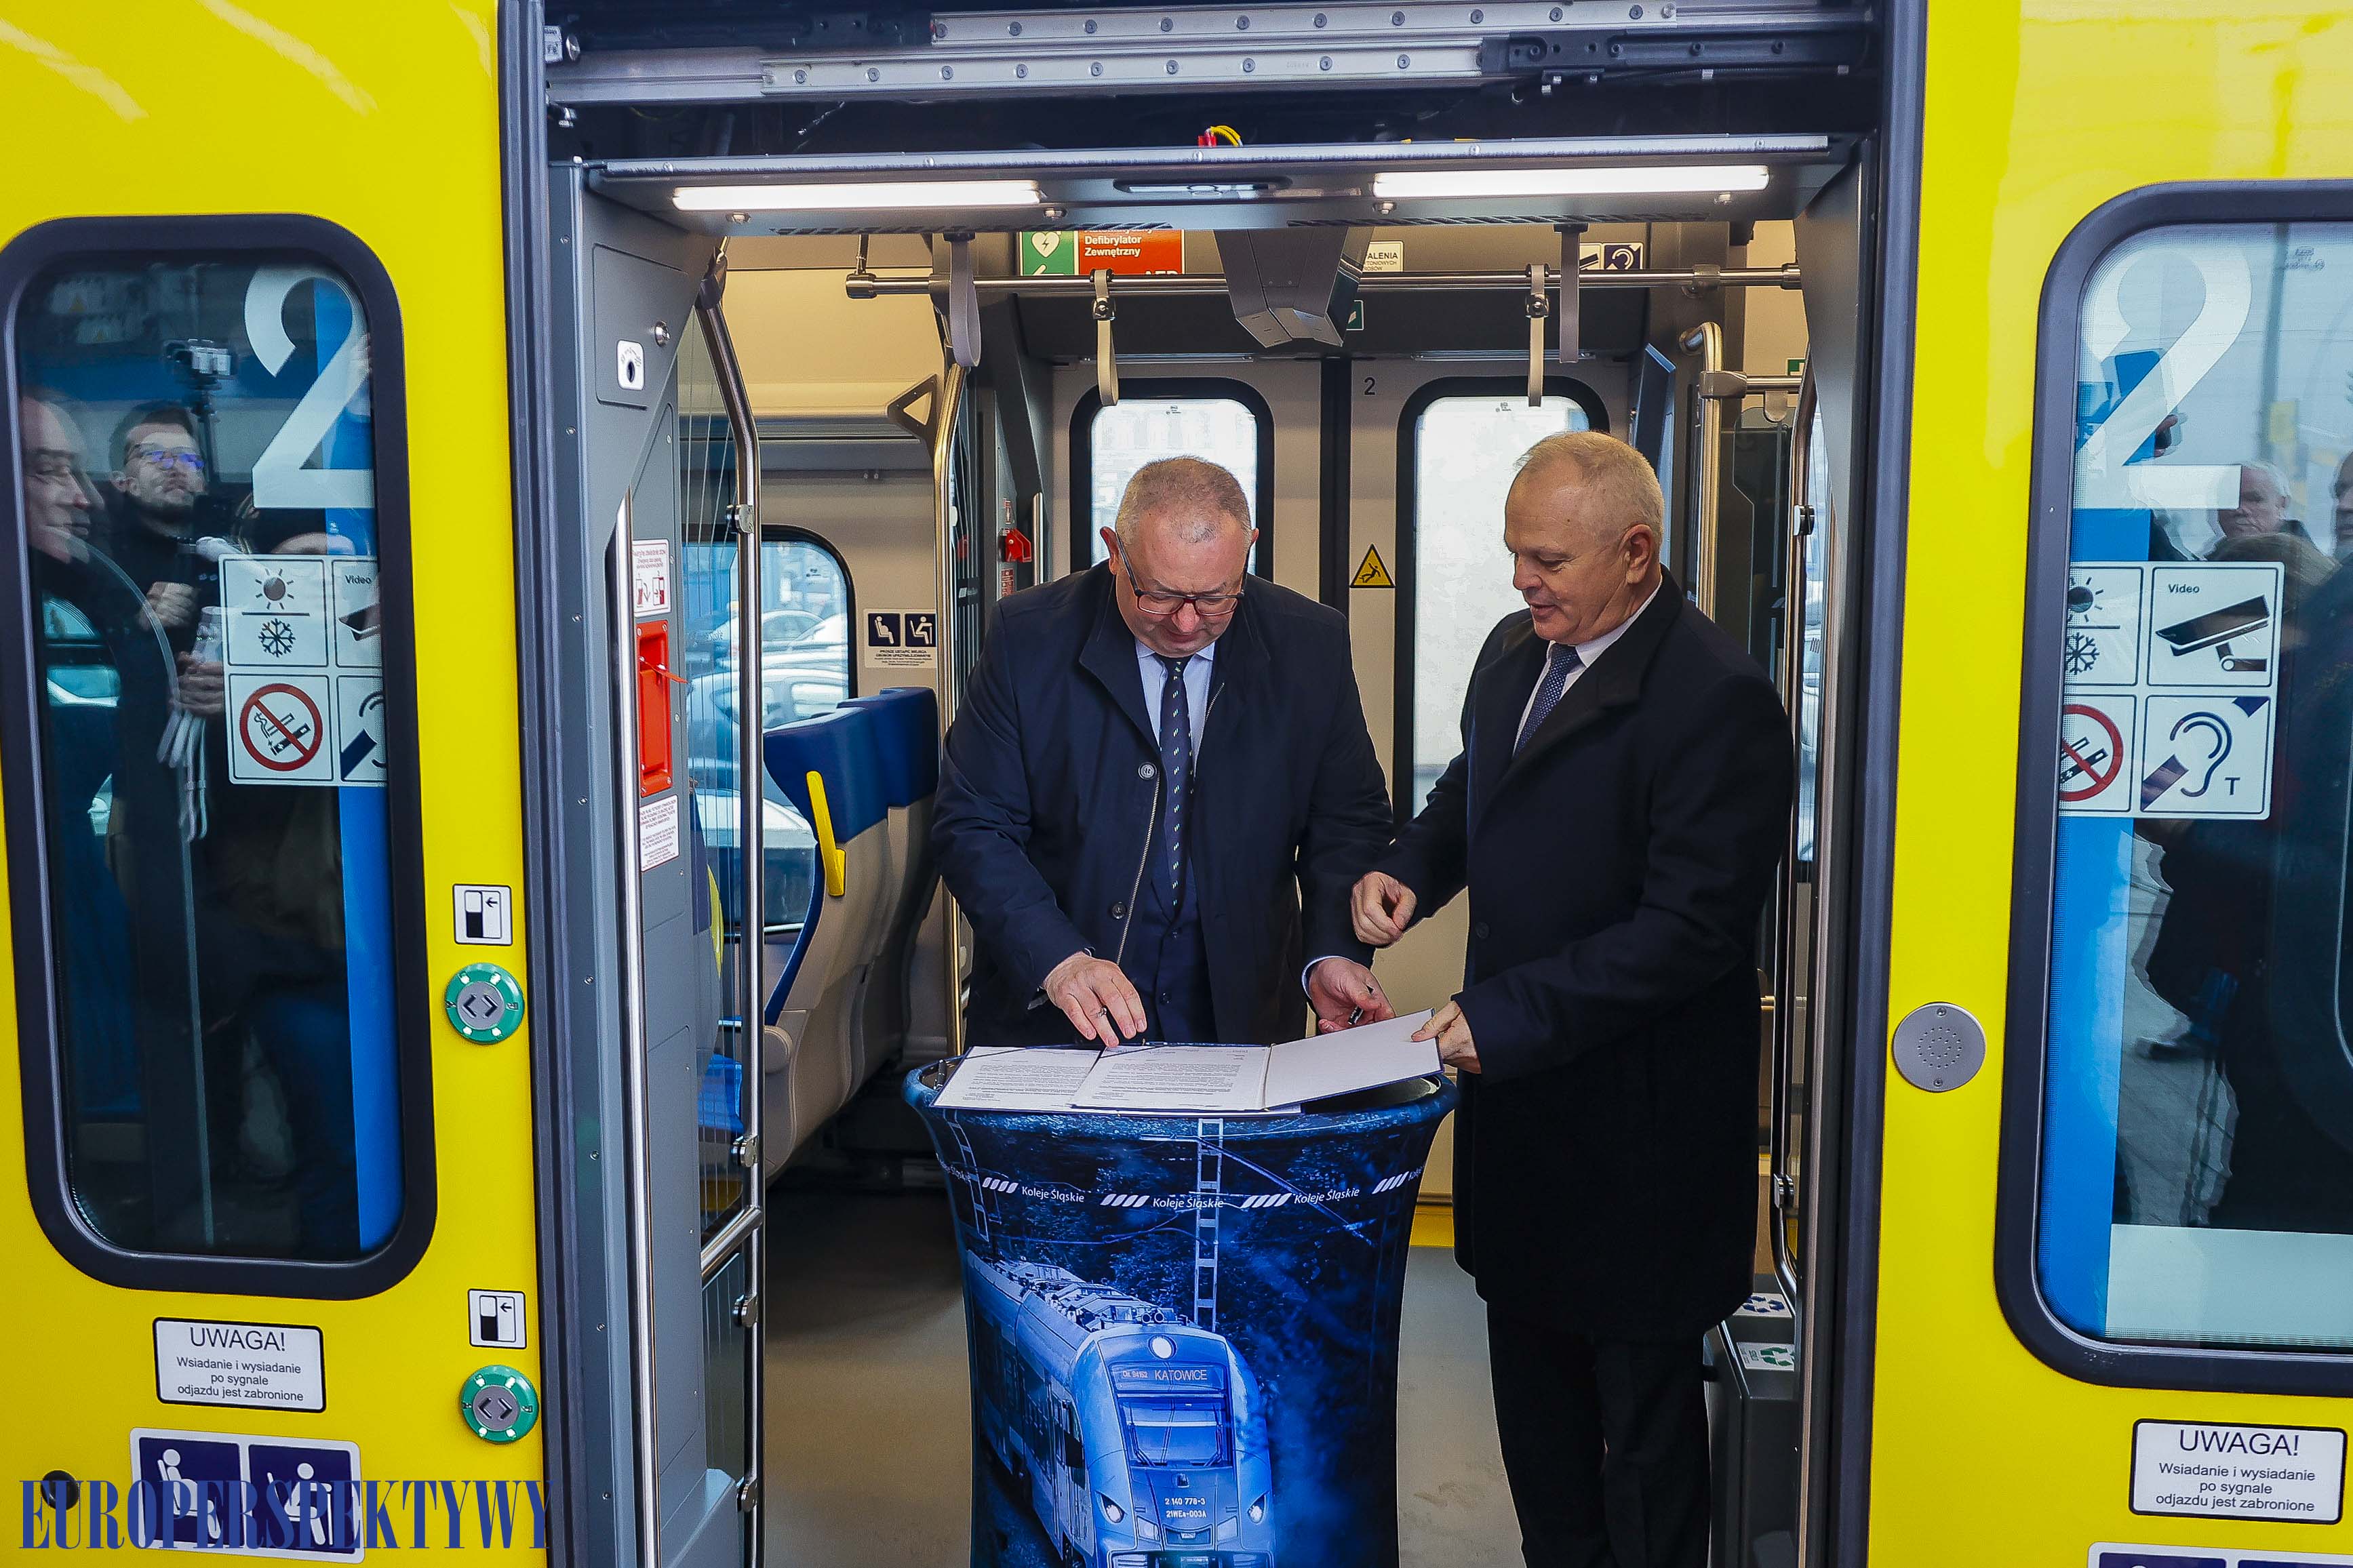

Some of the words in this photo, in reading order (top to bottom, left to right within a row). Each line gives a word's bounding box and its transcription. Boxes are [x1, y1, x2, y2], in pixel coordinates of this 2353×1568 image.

[1084, 235, 1142, 246] Defibrylator
[1084, 247, 1141, 258] Zewnętrzny
[2076, 245, 2253, 509] 2
[244, 263, 375, 509] 2
[1363, 378, 1376, 396] 2
[344, 575, 372, 585] Video
[2168, 583, 2200, 595] Video
[2224, 777, 2240, 795] T
[1022, 1186, 1049, 1200] Koleje
[1051, 1189, 1085, 1203] Śląskie
[1153, 1197, 1185, 1209] Koleje
[1187, 1197, 1224, 1209] Śląskie
[1294, 1191, 1325, 1205] Koleje
[1326, 1188, 1360, 1201] Śląskie
[190, 1327, 285, 1352] UWAGA!
[176, 1356, 233, 1370] Wsiadanie
[235, 1360, 239, 1369] i
[241, 1361, 301, 1373] wysiadanie
[211, 1373, 224, 1384] po
[227, 1374, 269, 1386] sygnale
[1155, 1369, 1207, 1381] KATOWICE
[178, 1384, 219, 1397] odjazdu
[222, 1387, 241, 1399] jest
[244, 1389, 304, 1401] zabronione
[2179, 1429, 2299, 1456] UWAGA!
[2159, 1462, 2229, 1476] Wsiadanie
[2233, 1466, 2237, 1476] i
[2240, 1468, 2315, 1481] wysiadanie
[2199, 1482, 2217, 1493] po
[2220, 1483, 2272, 1495] sygnale
[1171, 1497, 1183, 1506] 140
[2156, 1493, 2209, 1507] odjazdu
[2211, 1495, 2236, 1509] jest
[2240, 1497, 2315, 1512] zabronione
